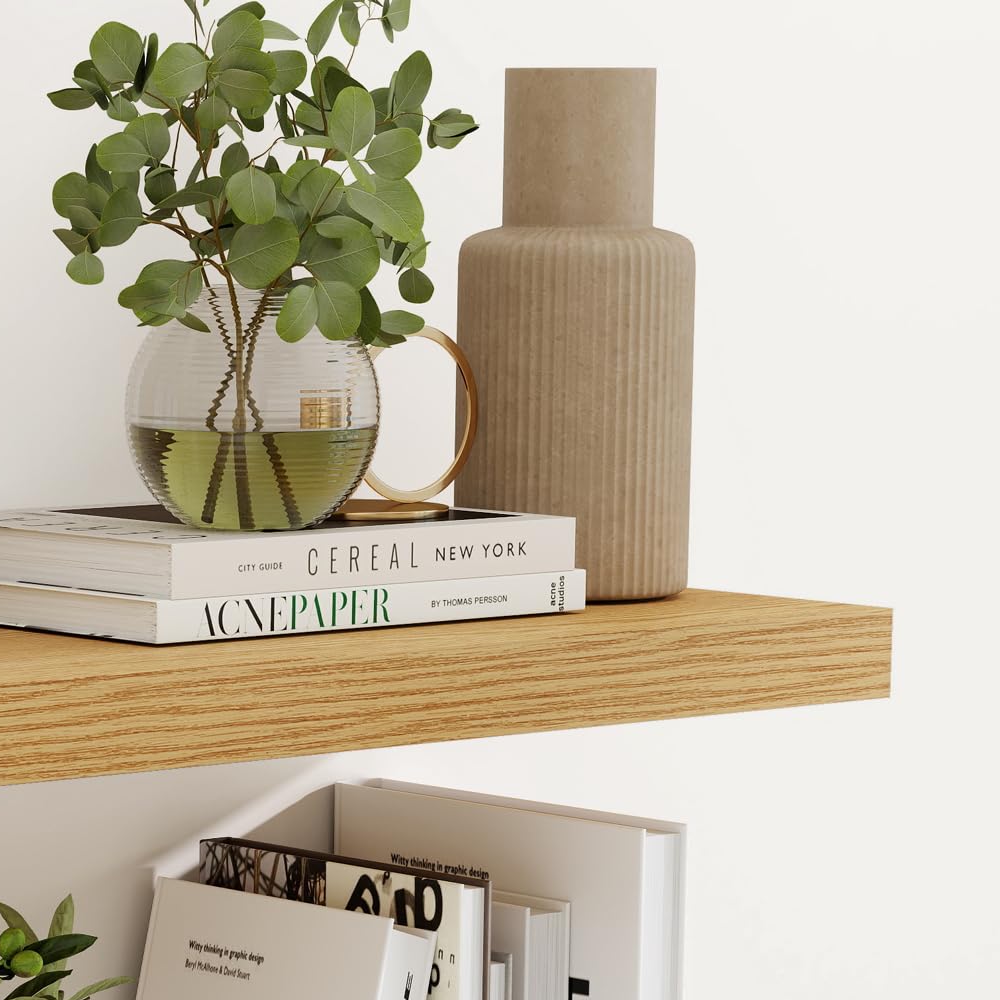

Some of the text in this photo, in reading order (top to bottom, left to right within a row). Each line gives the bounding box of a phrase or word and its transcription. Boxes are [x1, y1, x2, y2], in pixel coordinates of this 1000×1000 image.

[237, 541, 527, 576] CITY GUIDE CEREAL NEW YORK
[431, 599, 441, 608] BY
[443, 597, 472, 607] THOMAS
[474, 594, 508, 605] PERSSON
[390, 853, 489, 879] Witty thinking in graphic design
[189, 939, 265, 965] Witty thinking in graphic design
